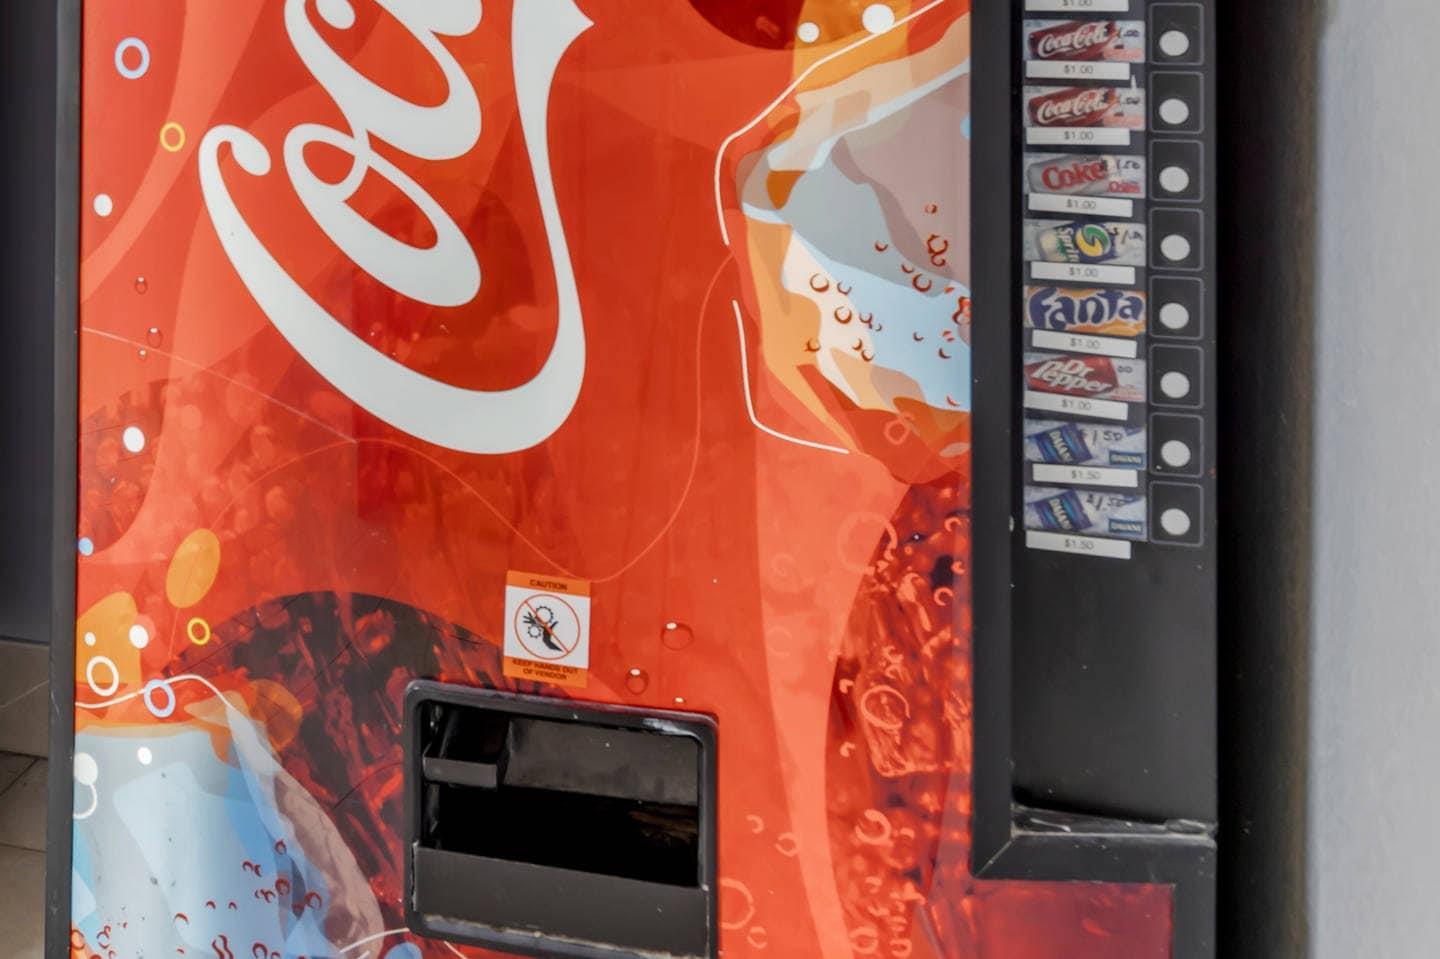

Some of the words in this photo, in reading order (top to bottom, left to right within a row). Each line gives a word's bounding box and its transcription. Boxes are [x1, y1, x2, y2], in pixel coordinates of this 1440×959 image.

[1063, 64, 1094, 74] $1.00
[1063, 130, 1094, 140] $1.00
[1041, 160, 1105, 192] Coke
[1065, 199, 1097, 210] $1.00
[1068, 266, 1099, 278] $1.00
[1070, 337, 1101, 349] $1.00
[1059, 359, 1094, 377] Dr
[1031, 360, 1112, 392] Pepper
[1061, 399, 1092, 410] $1.00
[529, 579, 568, 591] CAUTION
[513, 659, 533, 667] KEEP
[535, 662, 560, 672] HANDS
[562, 665, 578, 674] OUT
